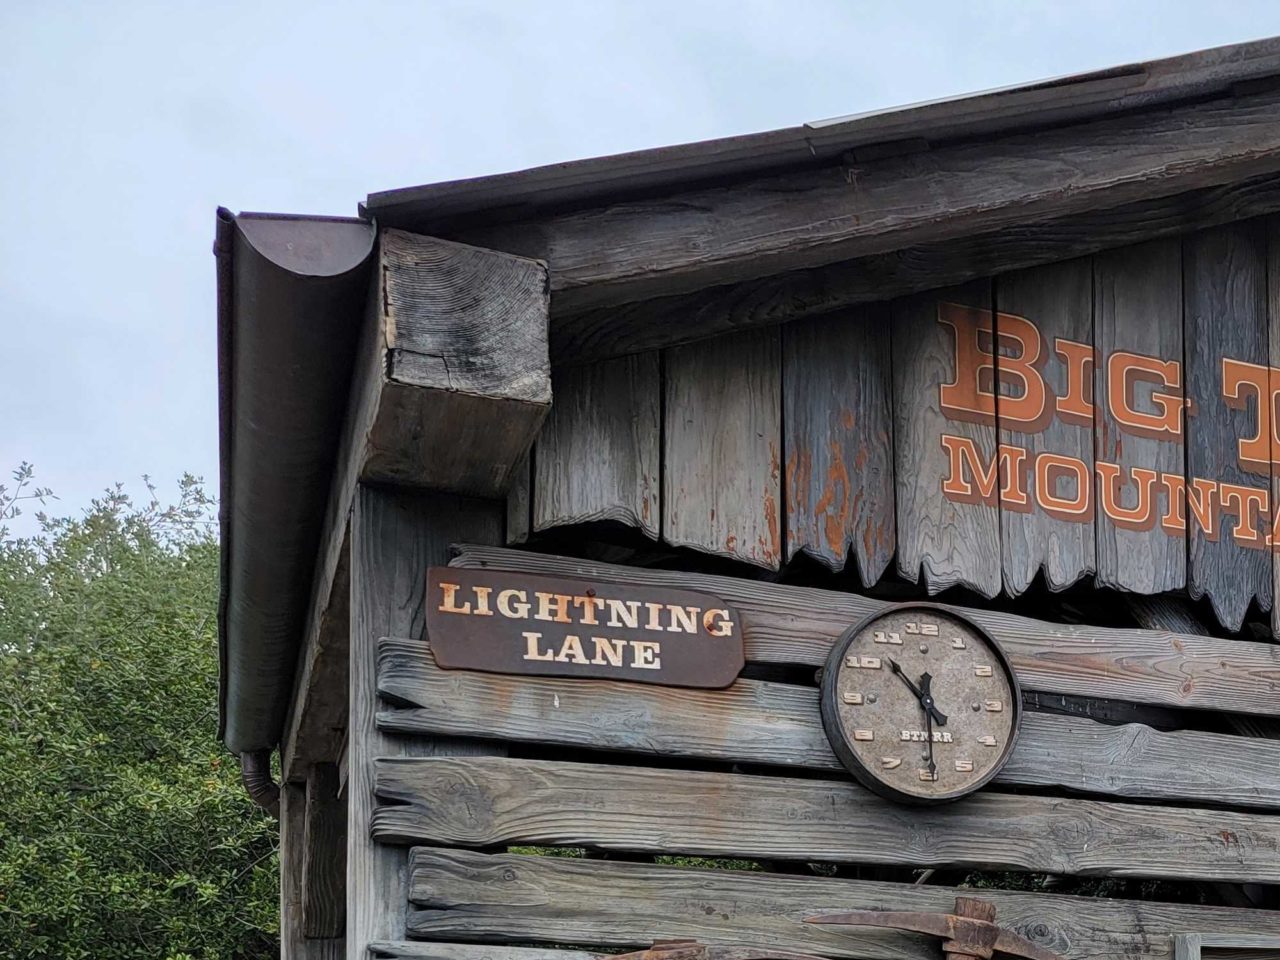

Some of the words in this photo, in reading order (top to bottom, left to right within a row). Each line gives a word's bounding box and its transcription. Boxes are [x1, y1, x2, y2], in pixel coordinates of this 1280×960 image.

[937, 300, 1190, 436] BIG
[438, 582, 734, 638] LIGHTNING
[905, 622, 939, 636] 12
[874, 631, 903, 645] 11
[522, 632, 662, 670] LANE
[845, 656, 882, 669] 10
[975, 665, 992, 677] 2
[955, 760, 973, 772] 5
